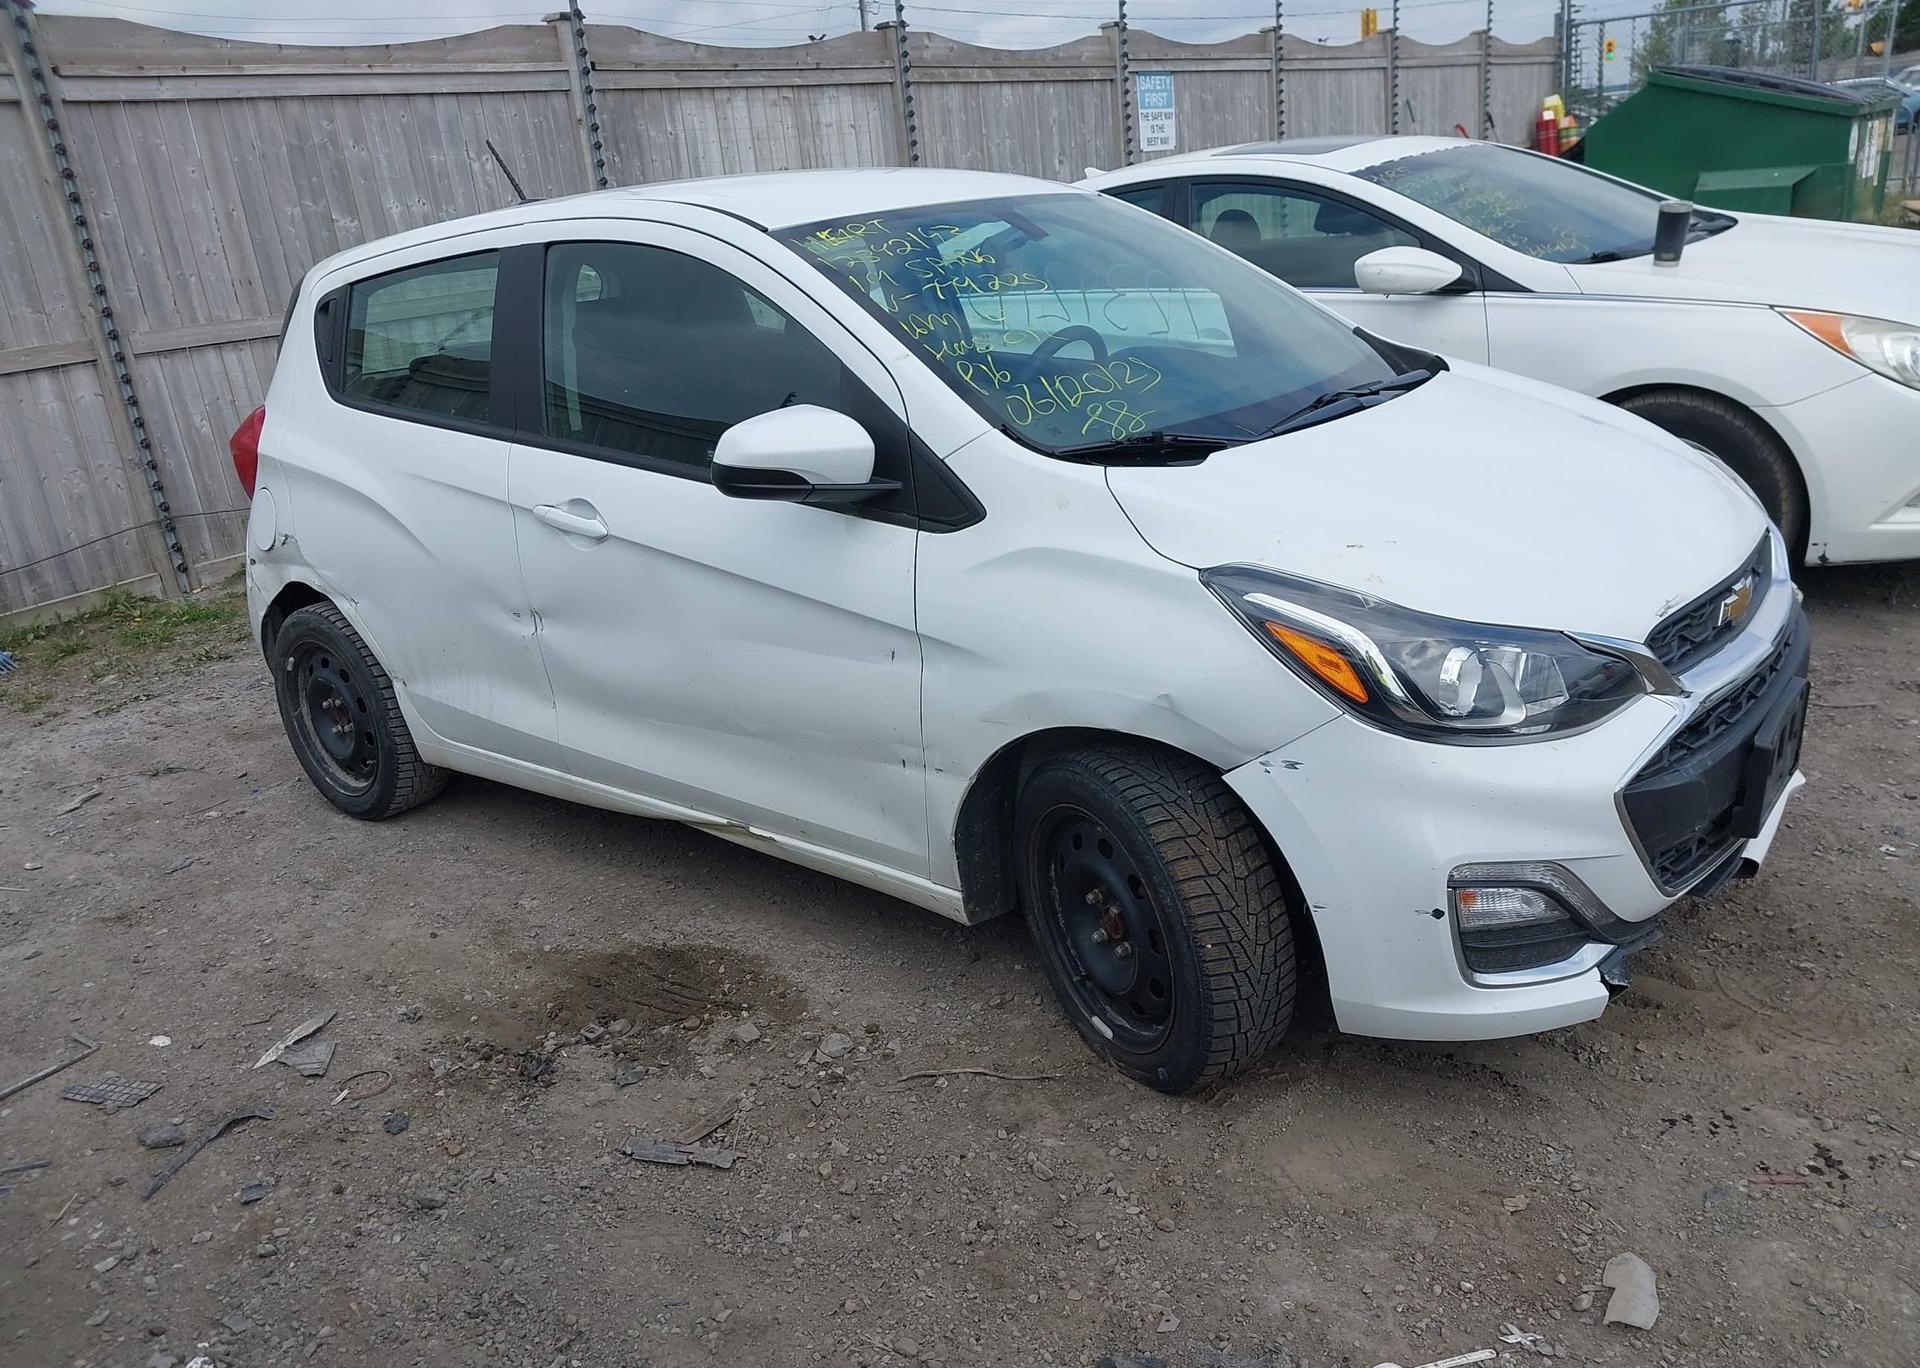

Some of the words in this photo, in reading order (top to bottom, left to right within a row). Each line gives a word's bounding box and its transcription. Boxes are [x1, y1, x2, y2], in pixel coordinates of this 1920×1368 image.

[1139, 75, 1170, 90] SAFETY
[1145, 92, 1168, 107] FIRST
[1140, 112, 1150, 121] THE
[1151, 112, 1163, 121] SAFE
[1164, 112, 1174, 120] WAY
[1155, 124, 1166, 133] THE
[1146, 137, 1158, 146] BEST
[1159, 137, 1170, 145] WAY
